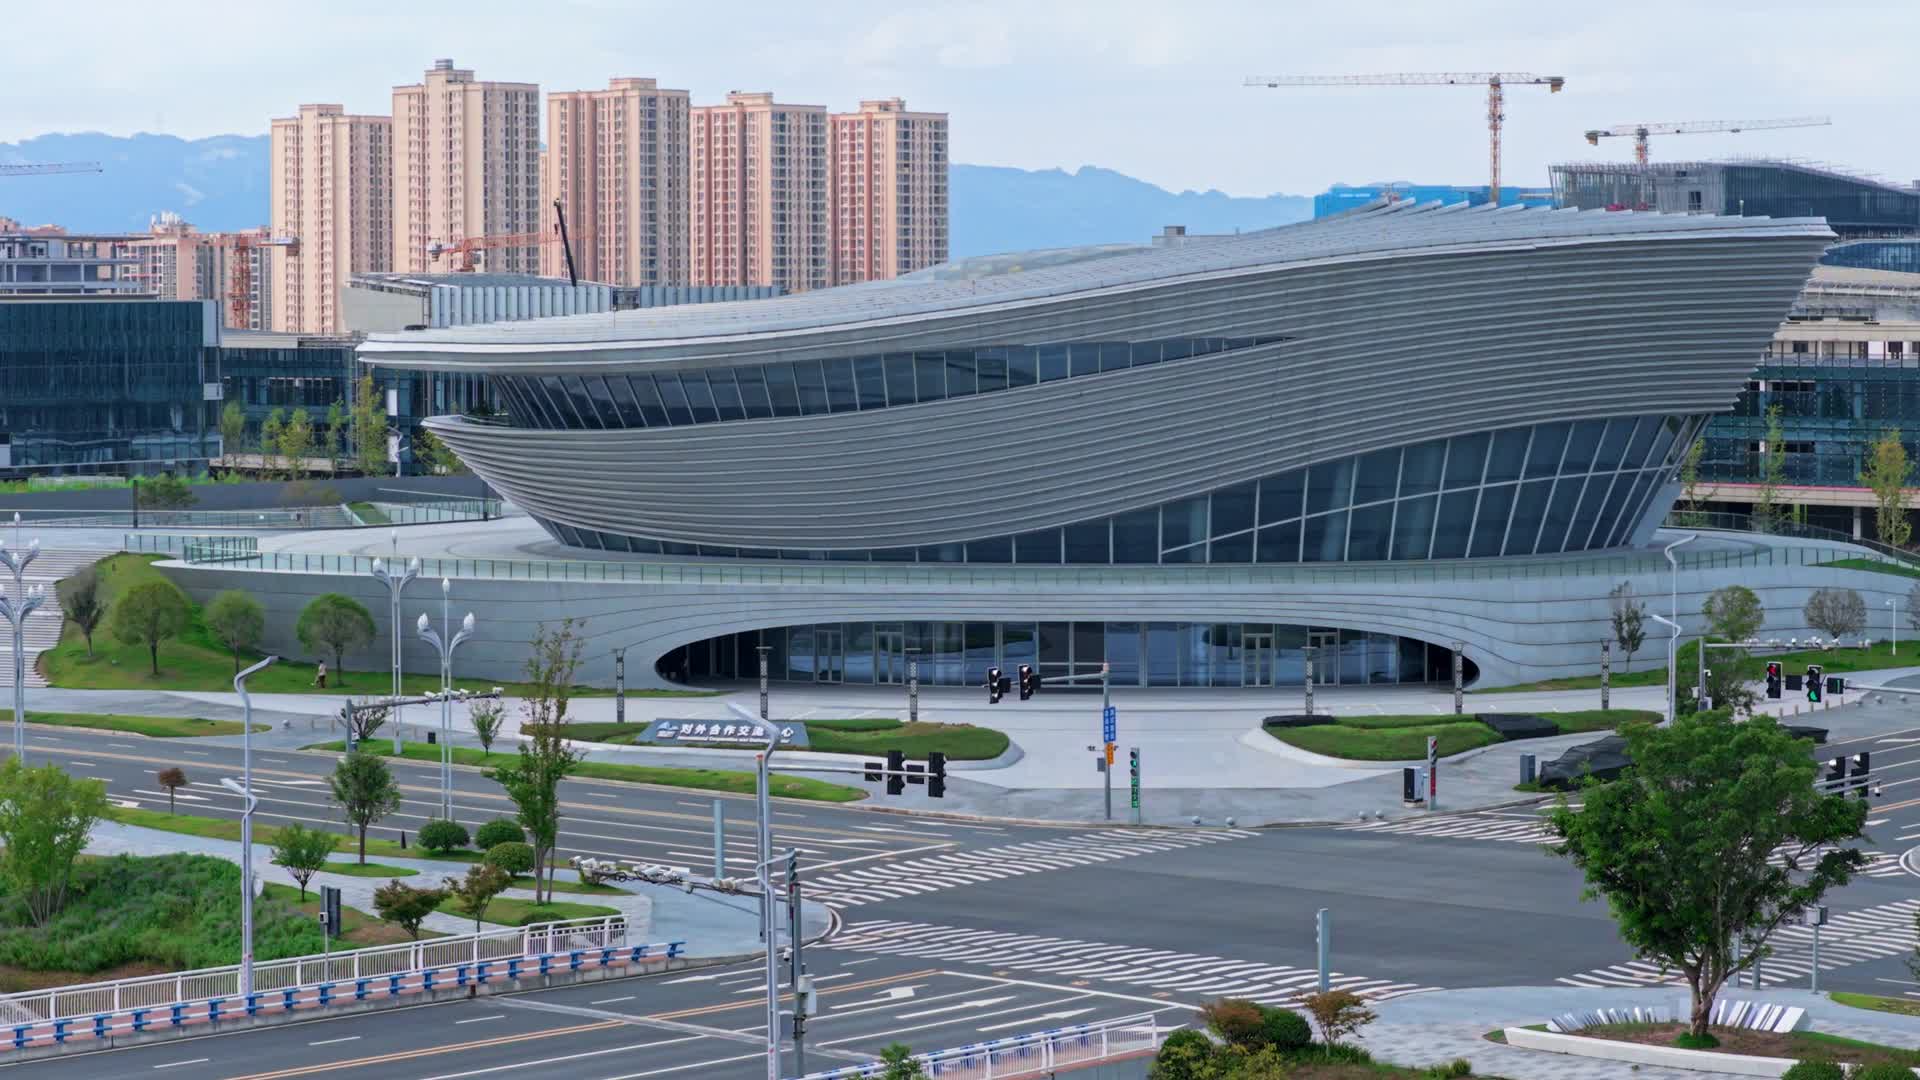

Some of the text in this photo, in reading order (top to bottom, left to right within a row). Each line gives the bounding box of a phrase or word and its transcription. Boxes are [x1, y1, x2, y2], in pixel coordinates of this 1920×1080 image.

[680, 723, 794, 737] 对外合作交流心
